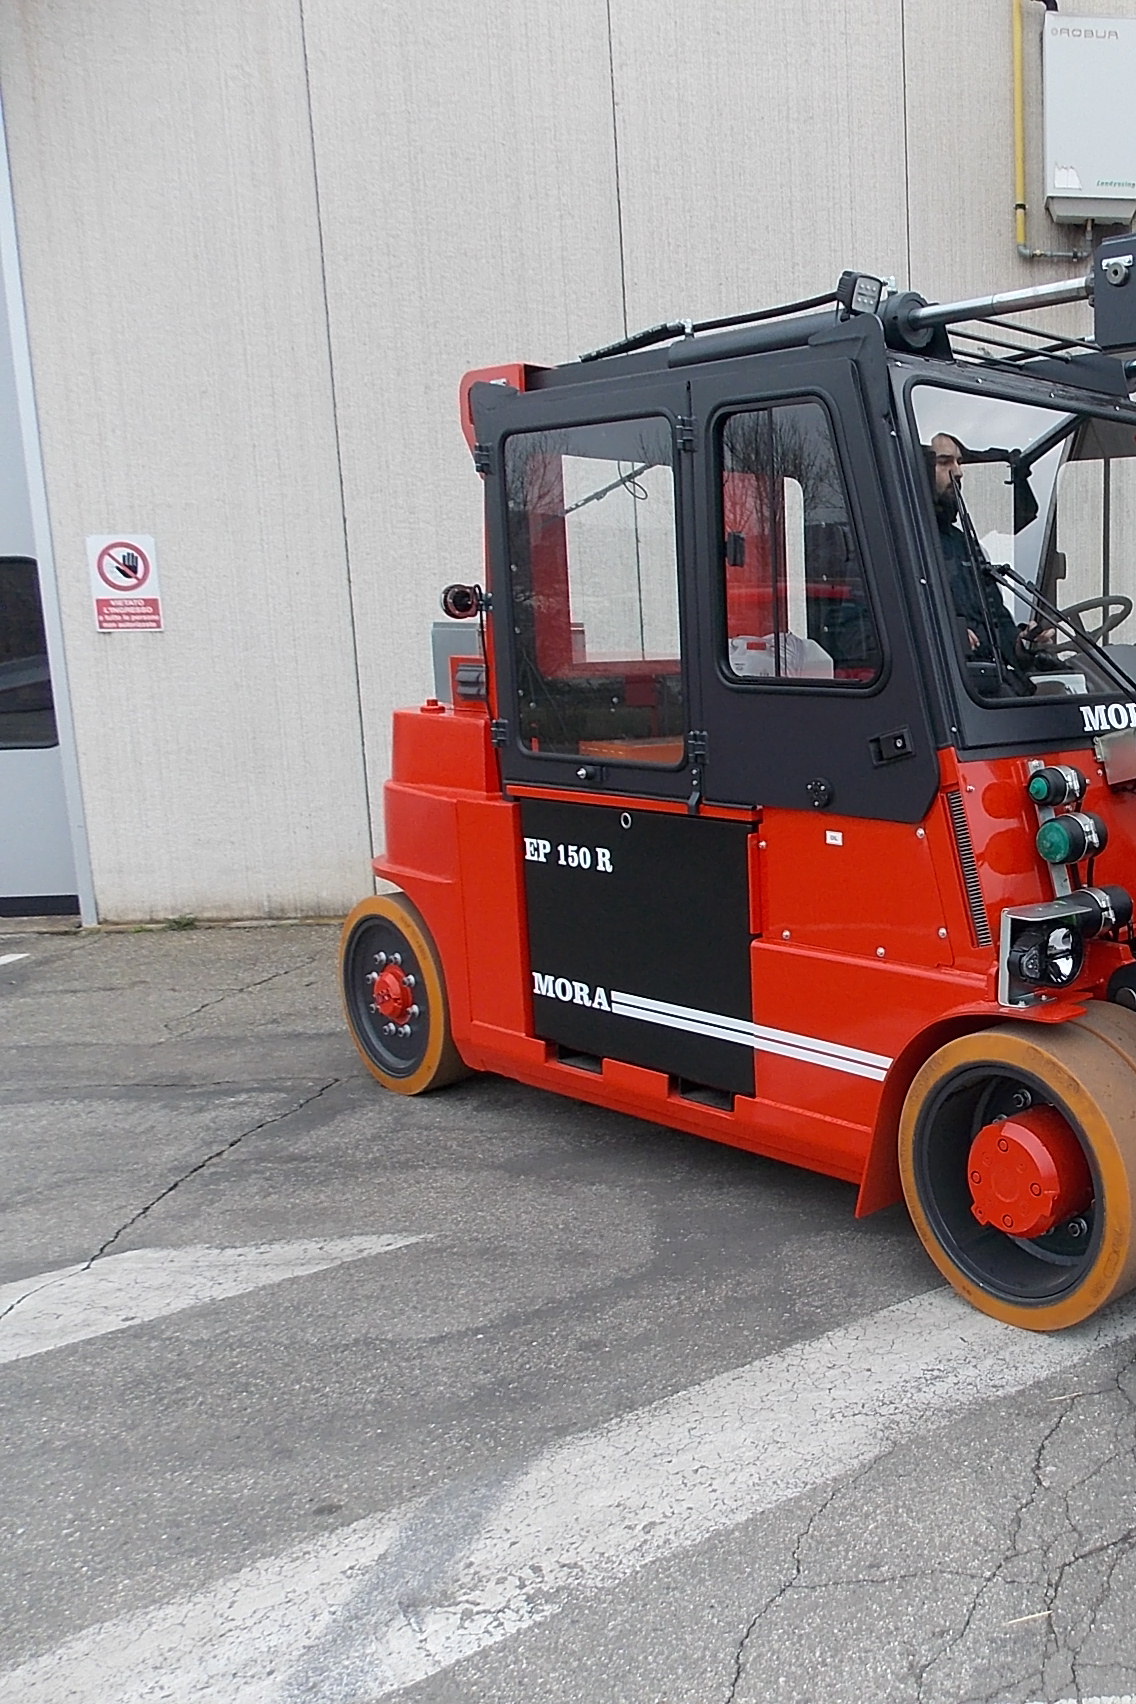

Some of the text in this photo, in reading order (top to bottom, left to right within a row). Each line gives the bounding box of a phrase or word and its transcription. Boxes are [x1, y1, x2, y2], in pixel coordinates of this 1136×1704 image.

[523, 837, 614, 873] EP 150 R
[532, 971, 611, 1012] MORA
